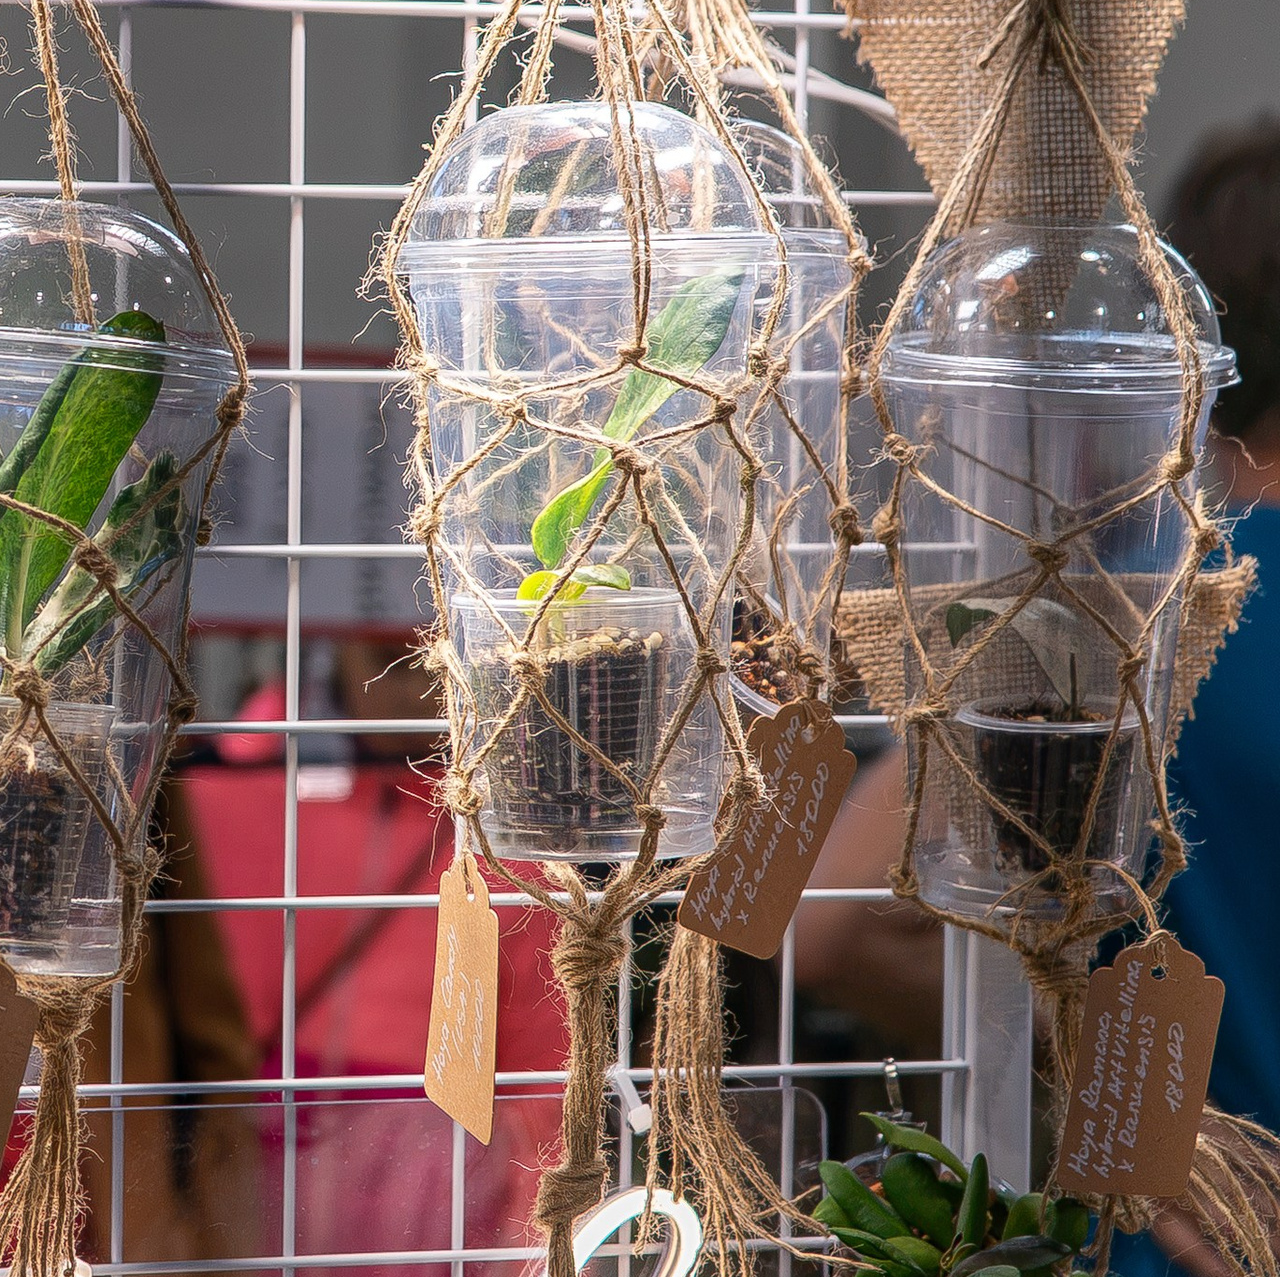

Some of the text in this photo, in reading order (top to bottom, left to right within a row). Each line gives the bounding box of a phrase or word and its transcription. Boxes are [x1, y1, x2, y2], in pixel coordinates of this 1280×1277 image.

[431, 923, 459, 1085] Hoya Candy
[1164, 1021, 1186, 1114] 18000
[1067, 1120, 1100, 1178] Hoya
[1092, 1102, 1119, 1179] hybrid
